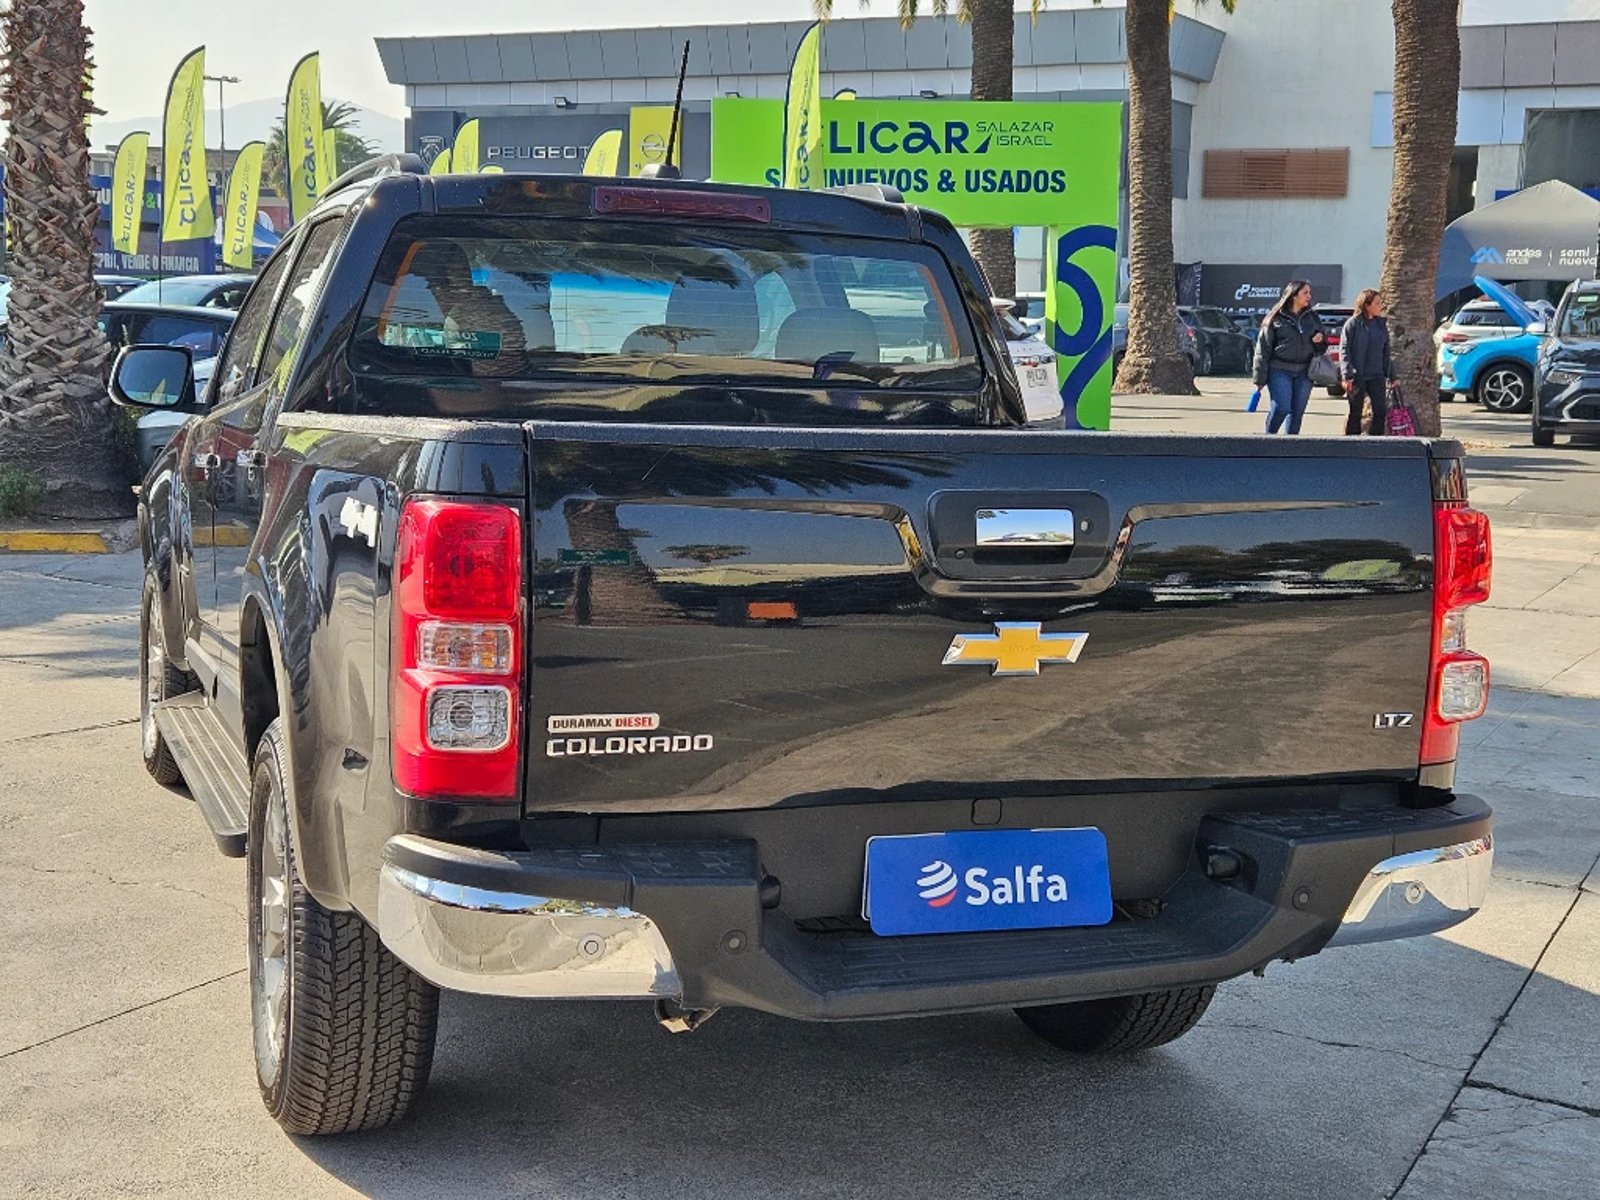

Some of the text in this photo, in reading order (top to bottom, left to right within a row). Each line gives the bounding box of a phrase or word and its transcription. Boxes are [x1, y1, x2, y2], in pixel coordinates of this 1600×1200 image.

[975, 121, 1054, 133] SALAZAR
[821, 120, 970, 155] LICAR
[996, 135, 1053, 146] ISRAEL
[486, 146, 589, 159] PEUGEOT
[937, 169, 957, 193] &
[965, 169, 1067, 193] USADOS
[552, 716, 655, 729] DURAMAX DIESEL
[1374, 713, 1413, 729] LTZ
[546, 734, 713, 757] COLORADO
[964, 865, 1068, 906] Salfa
